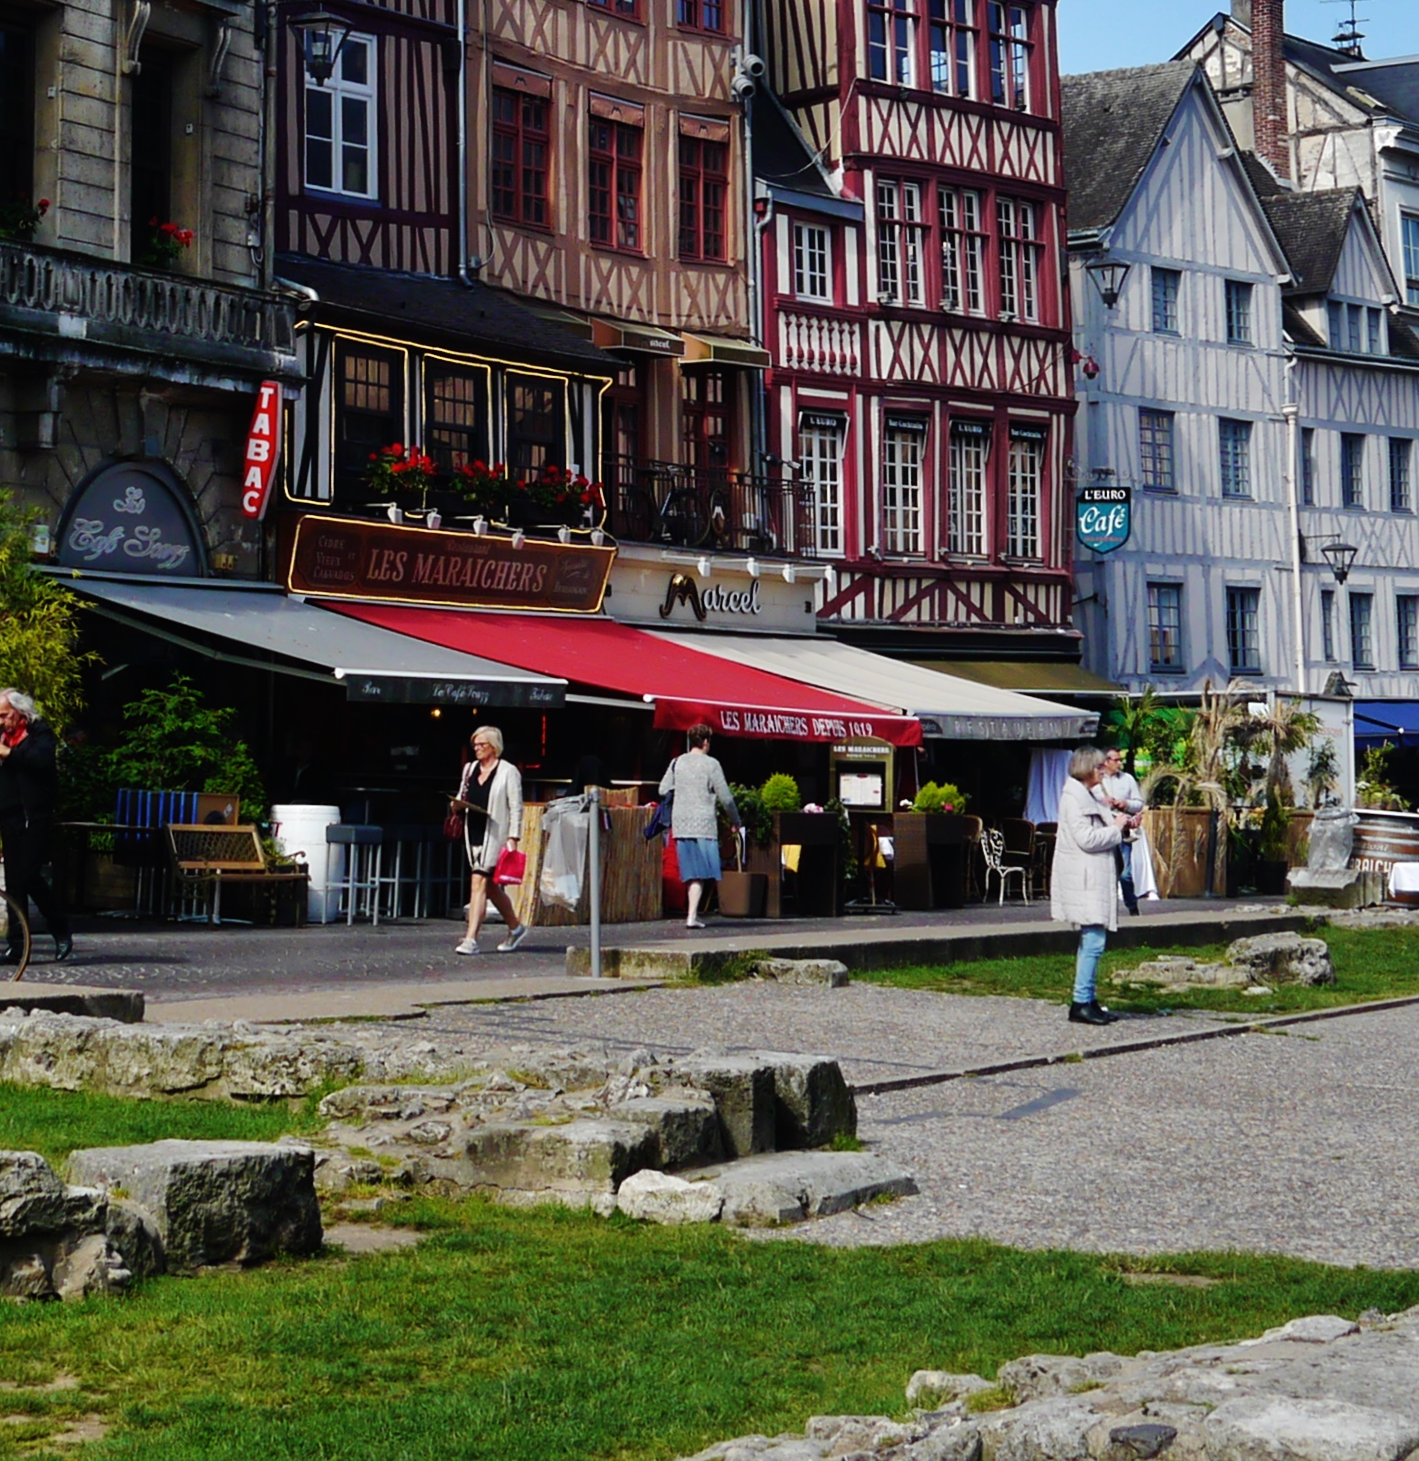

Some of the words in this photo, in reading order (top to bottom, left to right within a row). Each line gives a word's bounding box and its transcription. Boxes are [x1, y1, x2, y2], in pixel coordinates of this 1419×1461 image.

[243, 387, 274, 513] TABAC
[1084, 490, 1126, 500] L'EURO
[1079, 504, 1126, 546] Café
[367, 548, 408, 582] LES
[411, 553, 548, 593] MARAICHERS
[659, 573, 762, 621] Marcel
[720, 710, 740, 731] LES
[743, 712, 809, 736] MARAICHERS
[811, 717, 847, 738] DEPUIS
[953, 721, 1071, 737] RESTAURANT
